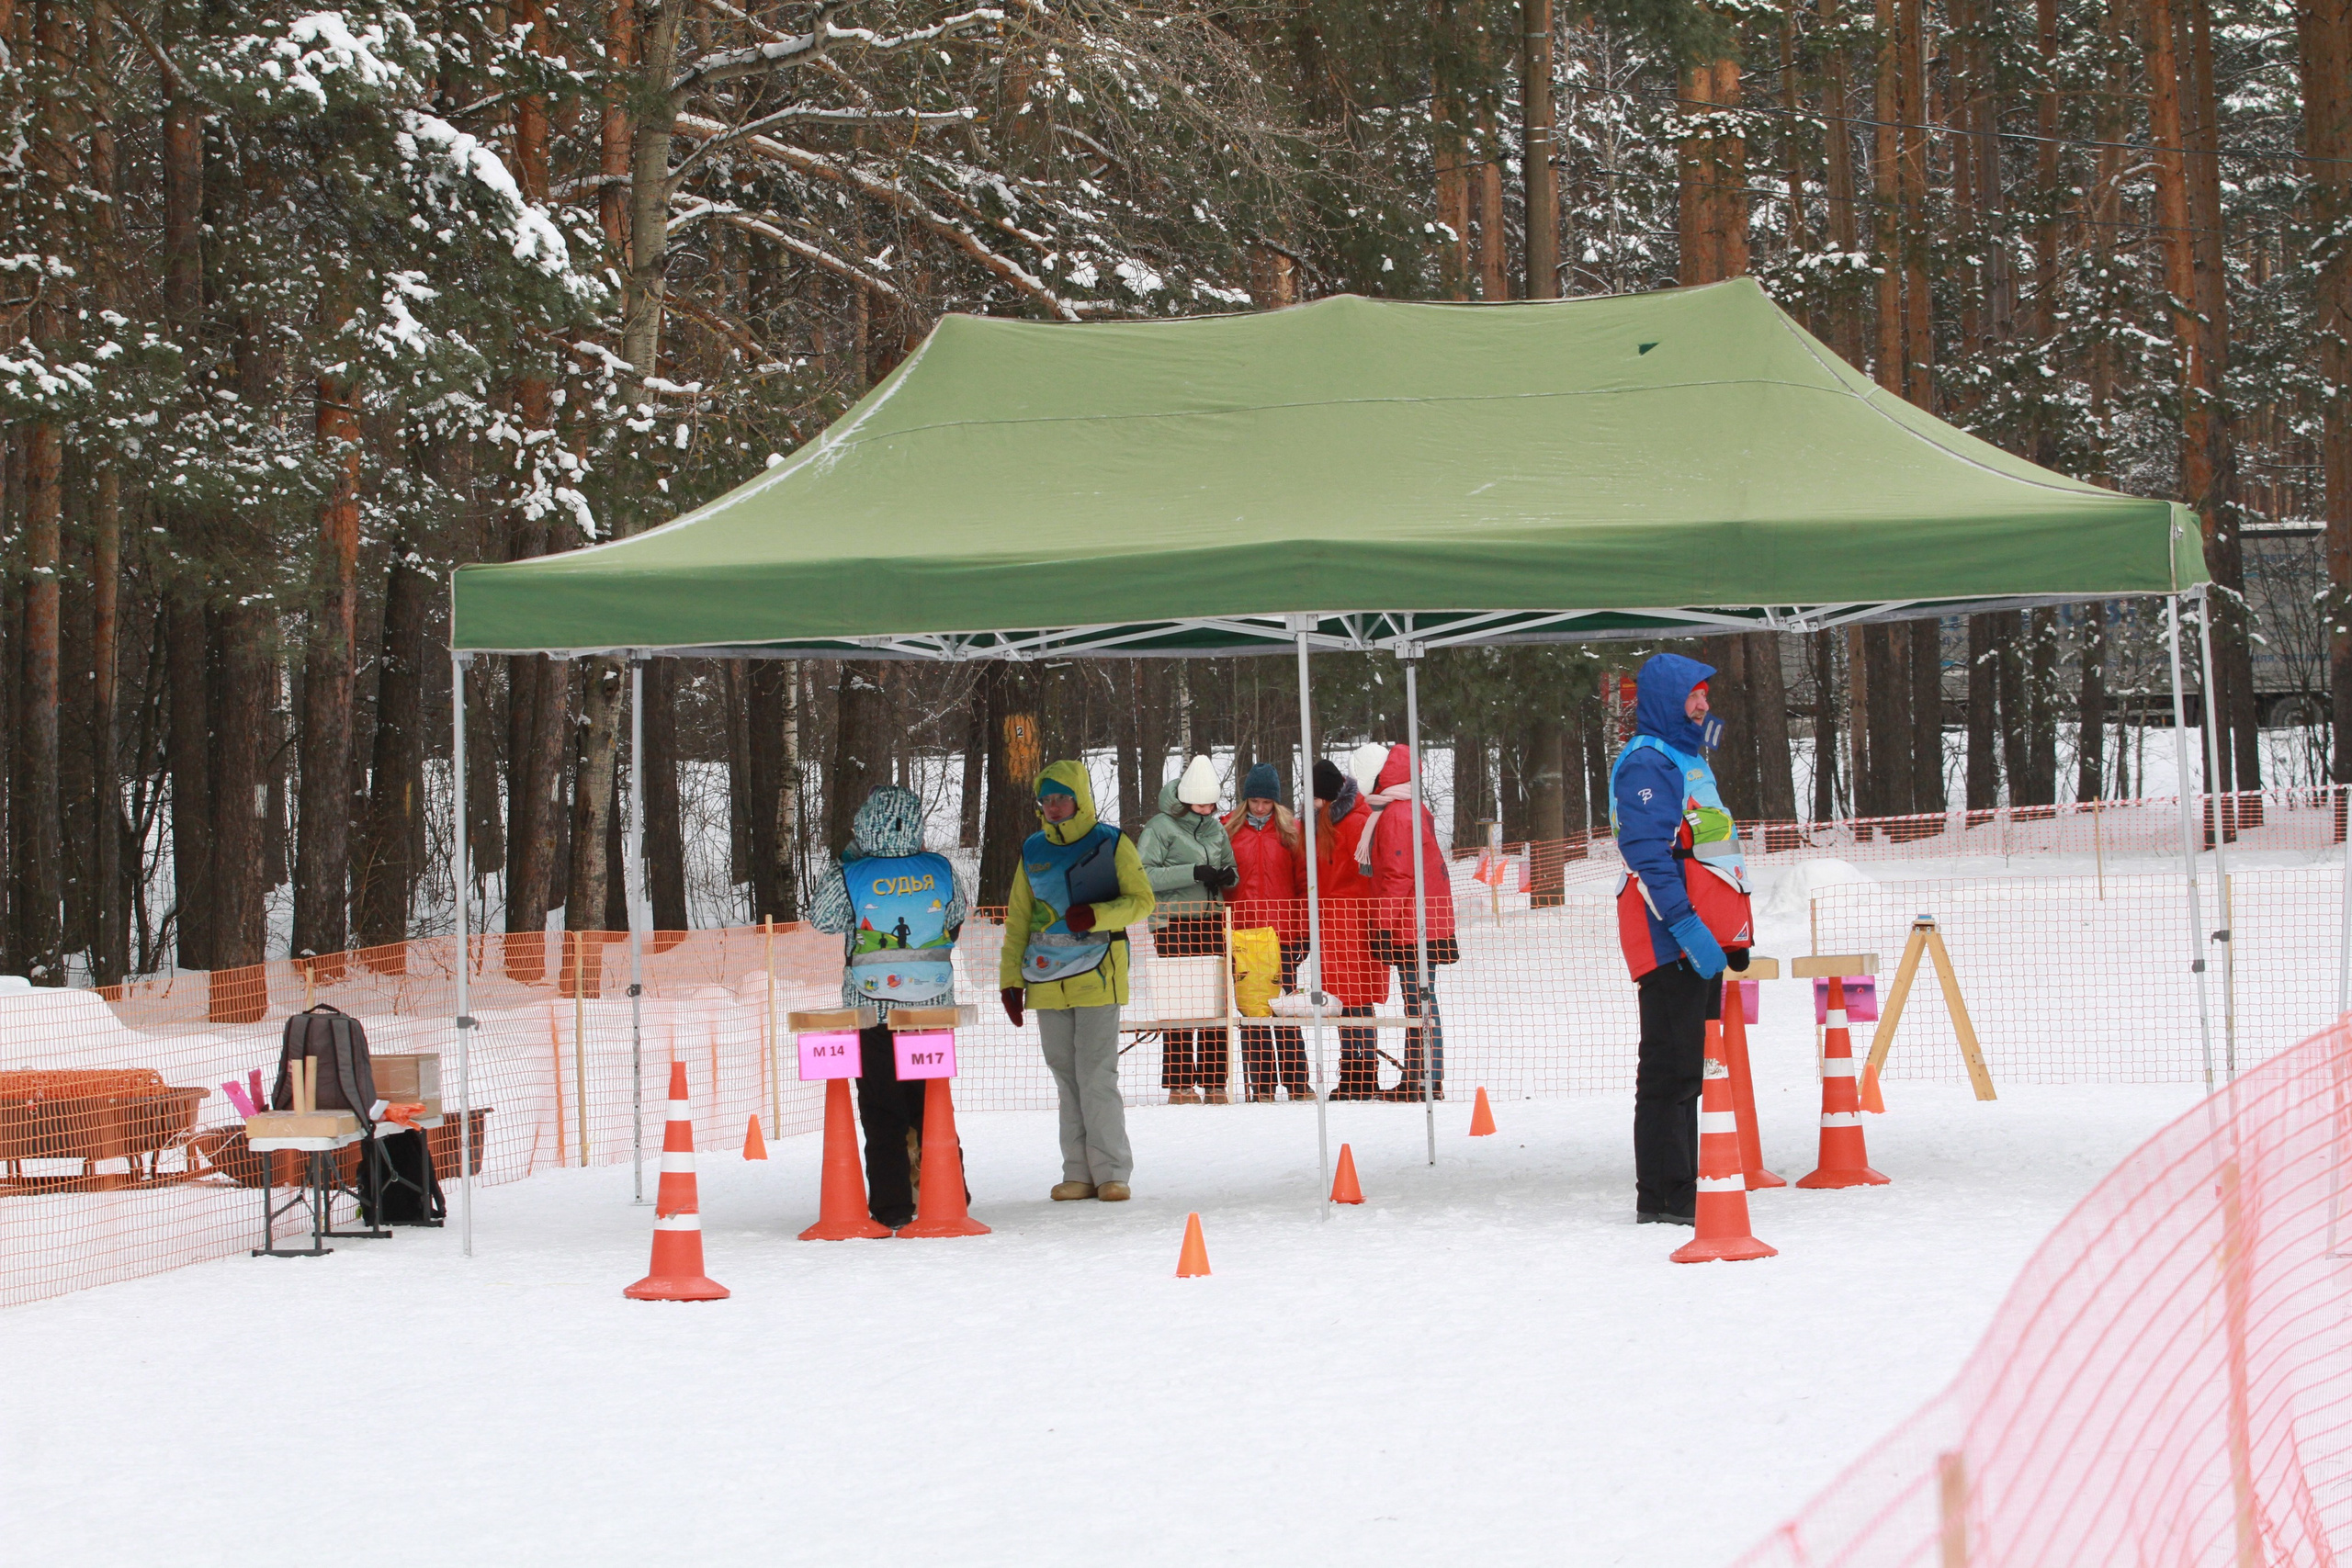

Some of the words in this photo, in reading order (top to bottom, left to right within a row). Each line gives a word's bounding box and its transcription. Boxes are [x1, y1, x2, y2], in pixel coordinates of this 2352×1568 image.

[872, 874, 935, 897] СУДЬЯ
[831, 1045, 845, 1056] 14
[911, 1052, 944, 1065] M17
